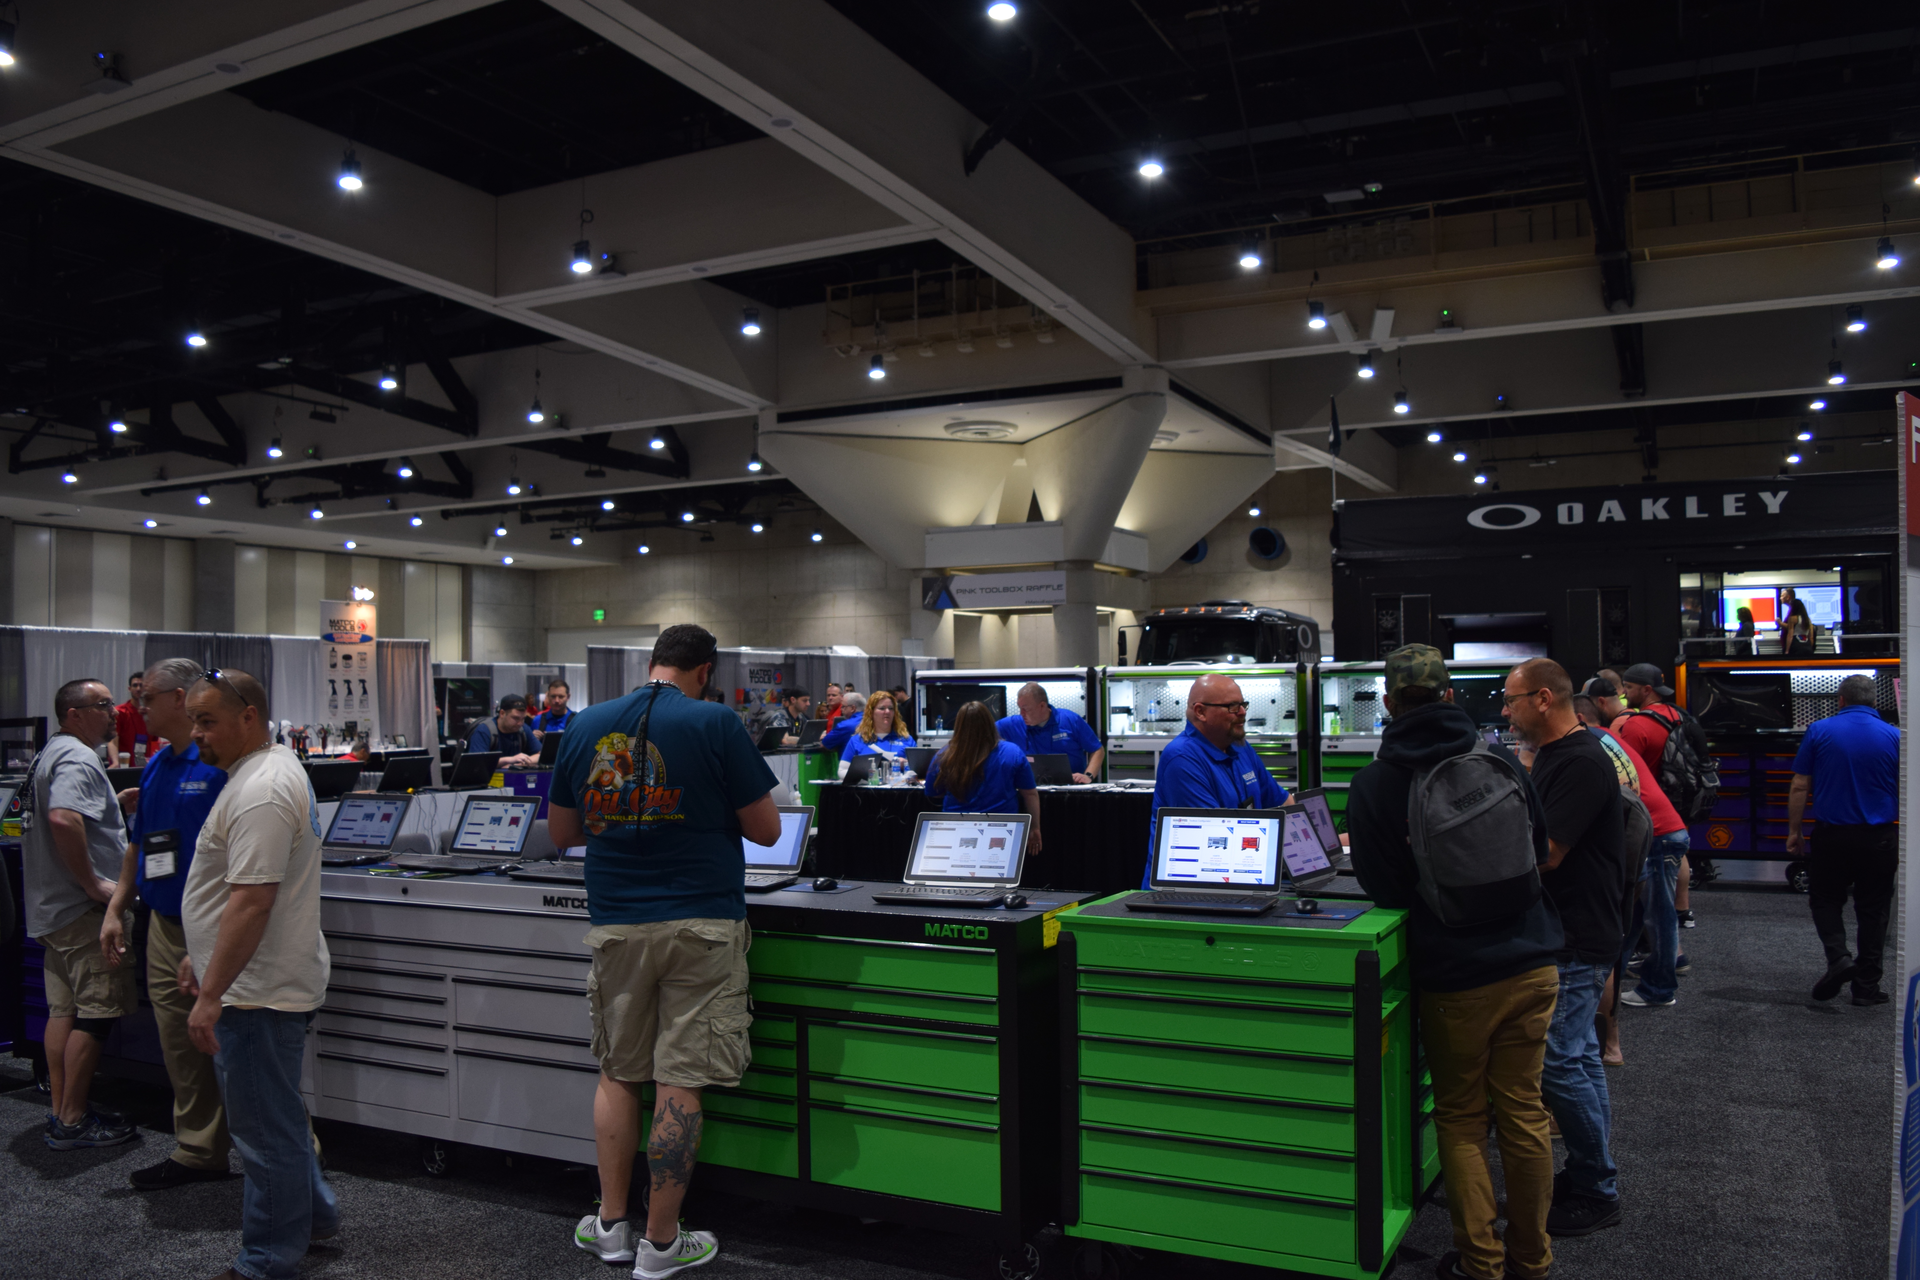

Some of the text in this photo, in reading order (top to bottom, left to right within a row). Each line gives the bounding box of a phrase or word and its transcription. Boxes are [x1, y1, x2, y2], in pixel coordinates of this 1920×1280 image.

[1556, 490, 1789, 526] OAKLEY
[979, 585, 1024, 594] TOOLBOX
[1026, 583, 1064, 592] RAFFLE
[584, 784, 682, 815] Oil City
[924, 922, 989, 941] MATCO
[1107, 939, 1292, 968] MATCO TOOLS
